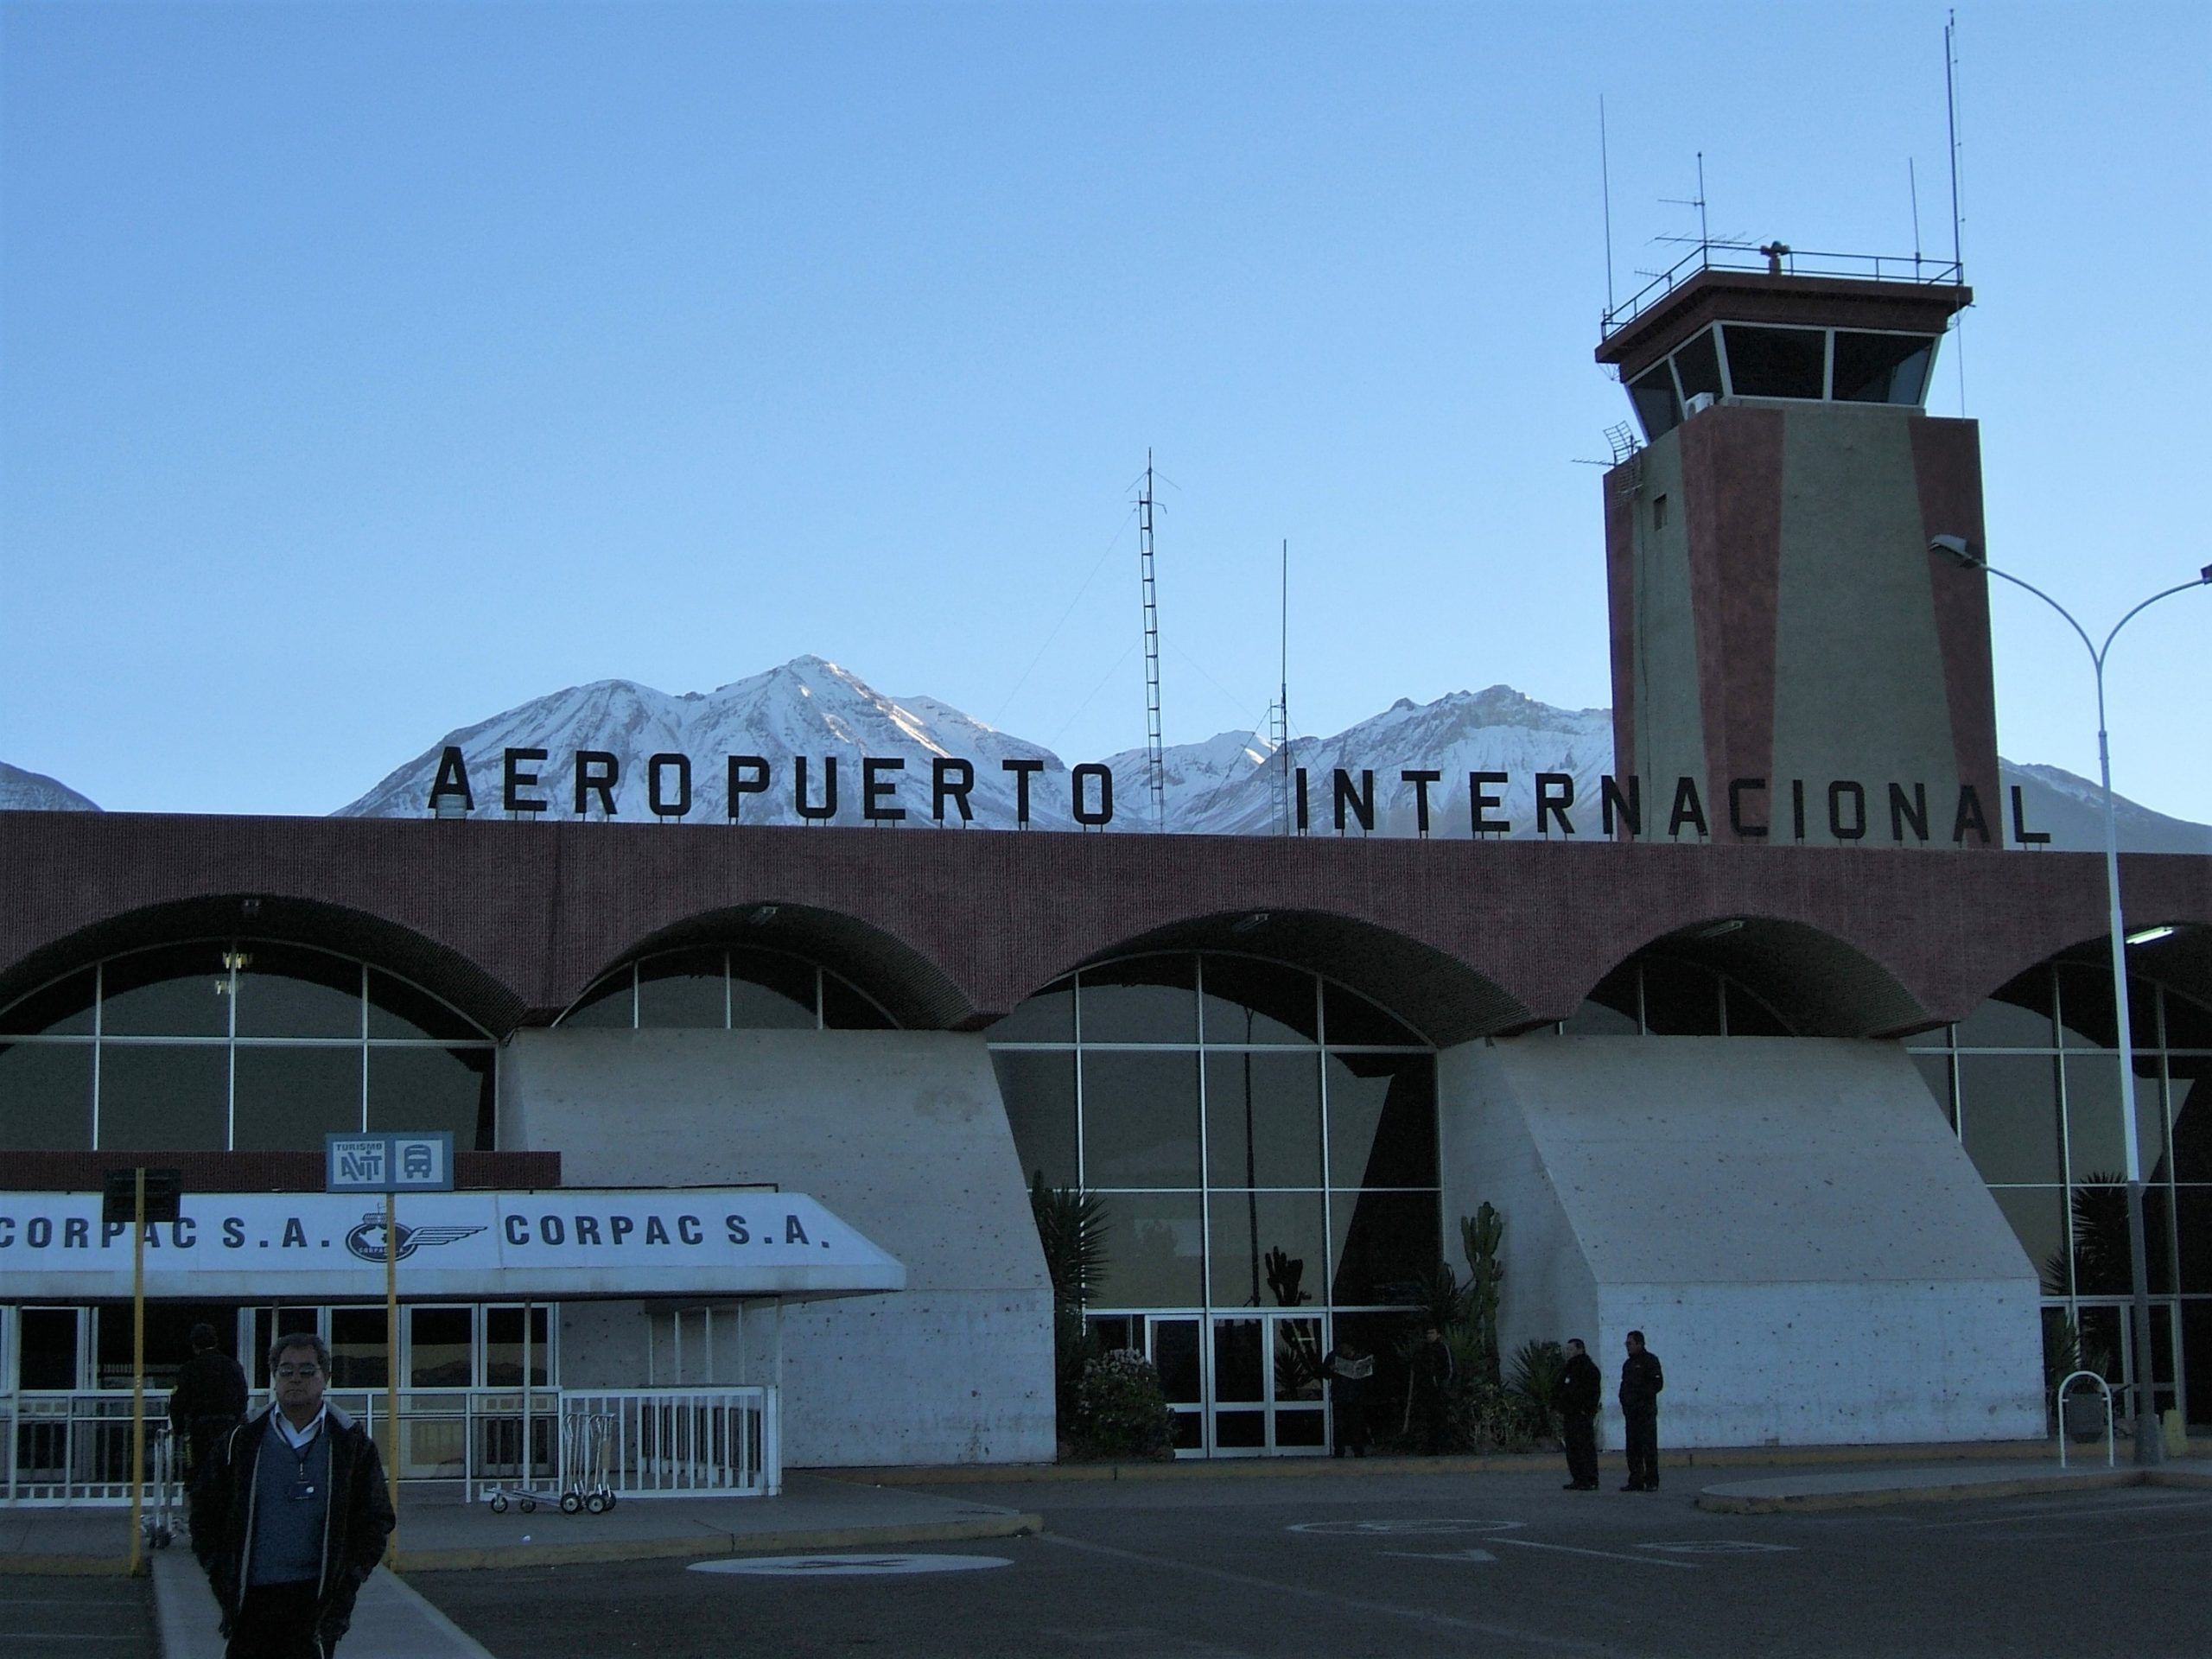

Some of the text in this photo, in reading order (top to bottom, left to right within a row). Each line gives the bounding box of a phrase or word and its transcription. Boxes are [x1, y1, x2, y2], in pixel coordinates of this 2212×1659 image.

[428, 747, 2050, 843] AEROPUERTO INTERNACIONAL
[223, 1217, 330, 1248] S.A.
[505, 1214, 830, 1249] CORPAC S.A.
